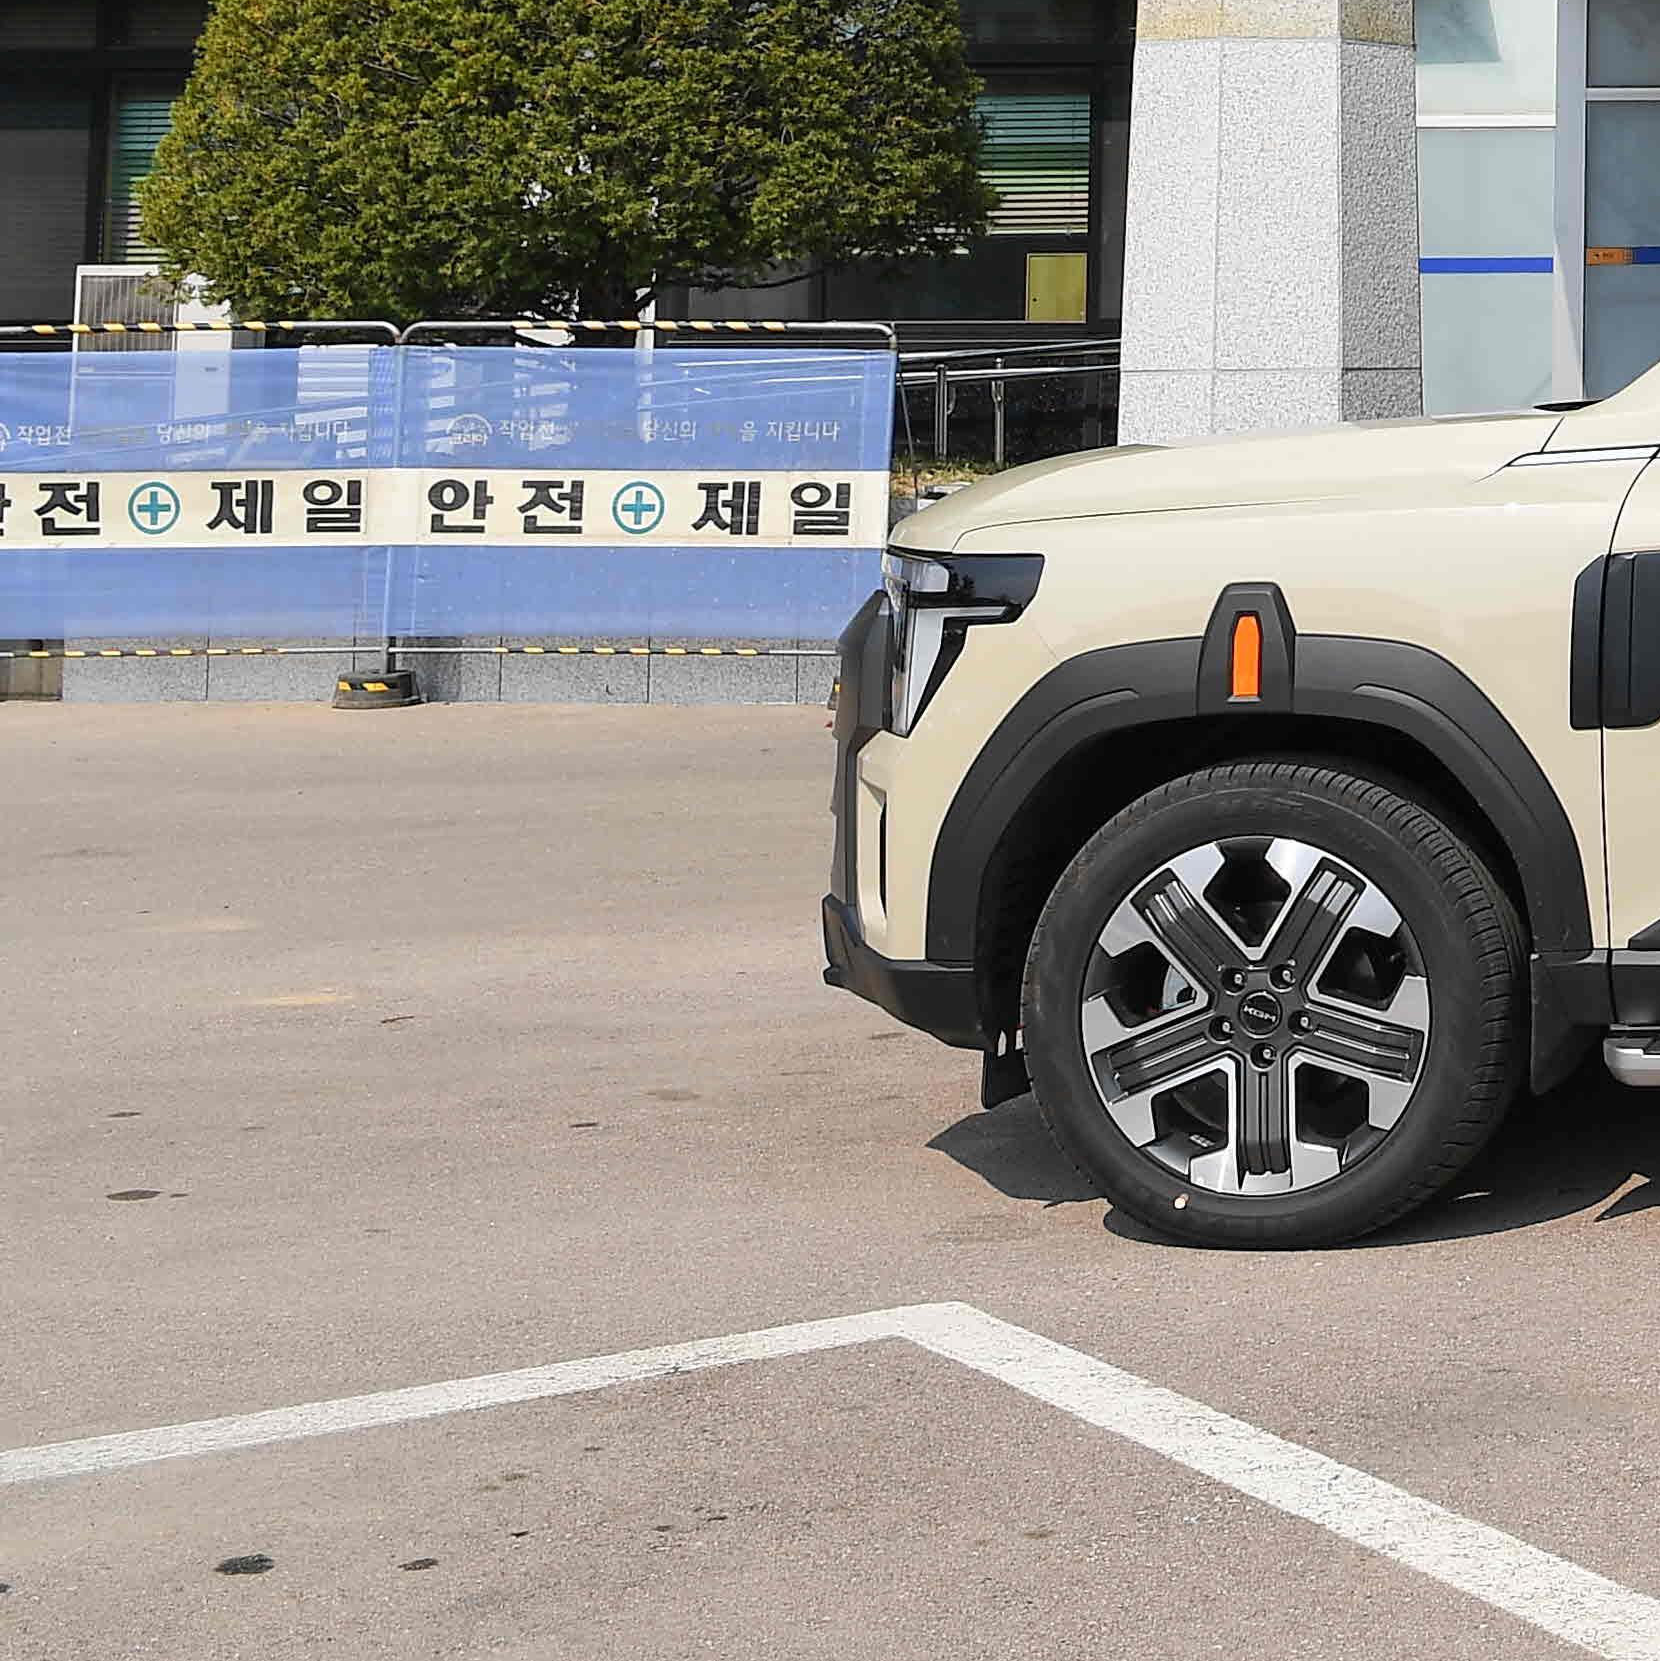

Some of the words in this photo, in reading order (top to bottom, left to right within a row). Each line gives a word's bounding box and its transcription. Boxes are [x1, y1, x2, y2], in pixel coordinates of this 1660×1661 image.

[0, 480, 101, 536] 전
[428, 479, 584, 534] 안전
[691, 480, 851, 536] 제일
